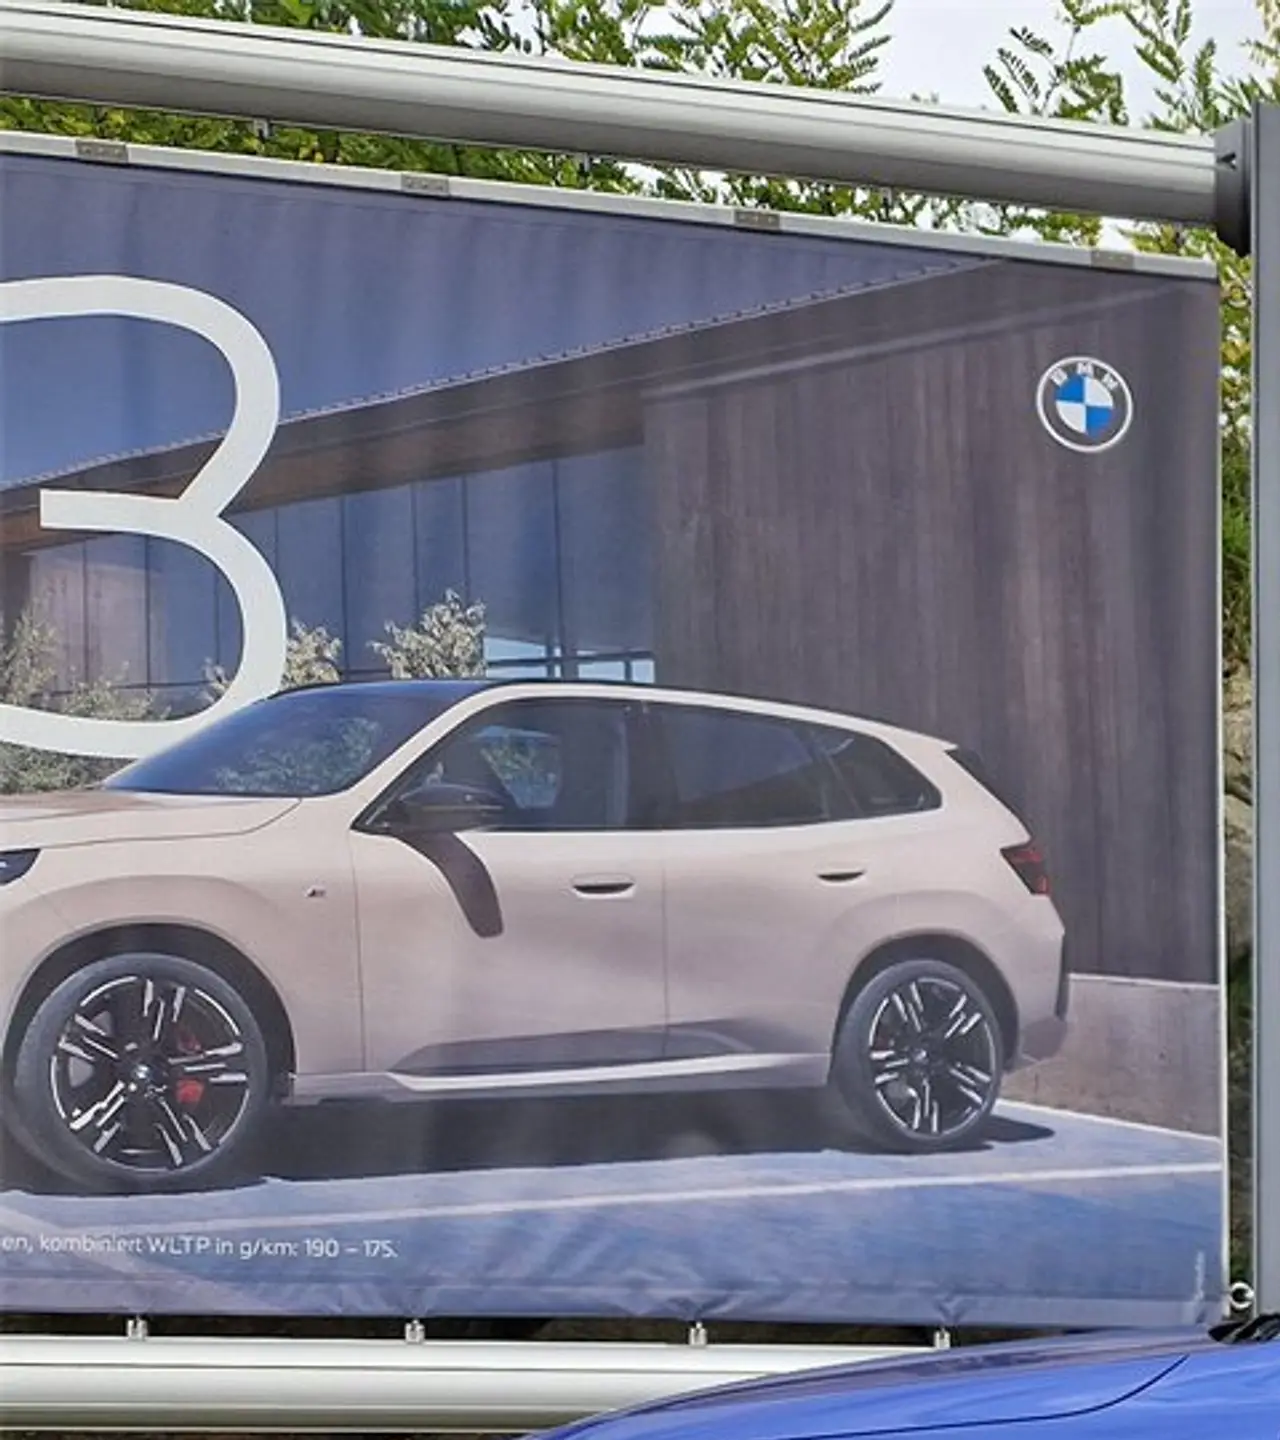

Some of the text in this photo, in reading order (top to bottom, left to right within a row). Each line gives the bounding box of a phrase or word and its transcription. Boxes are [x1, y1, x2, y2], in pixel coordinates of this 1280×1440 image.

[146, 1235, 211, 1255] WLTP
[215, 1236, 234, 1256] in
[239, 1237, 298, 1260] g/km:
[304, 1237, 340, 1258] 190
[362, 1239, 398, 1259] 175.
